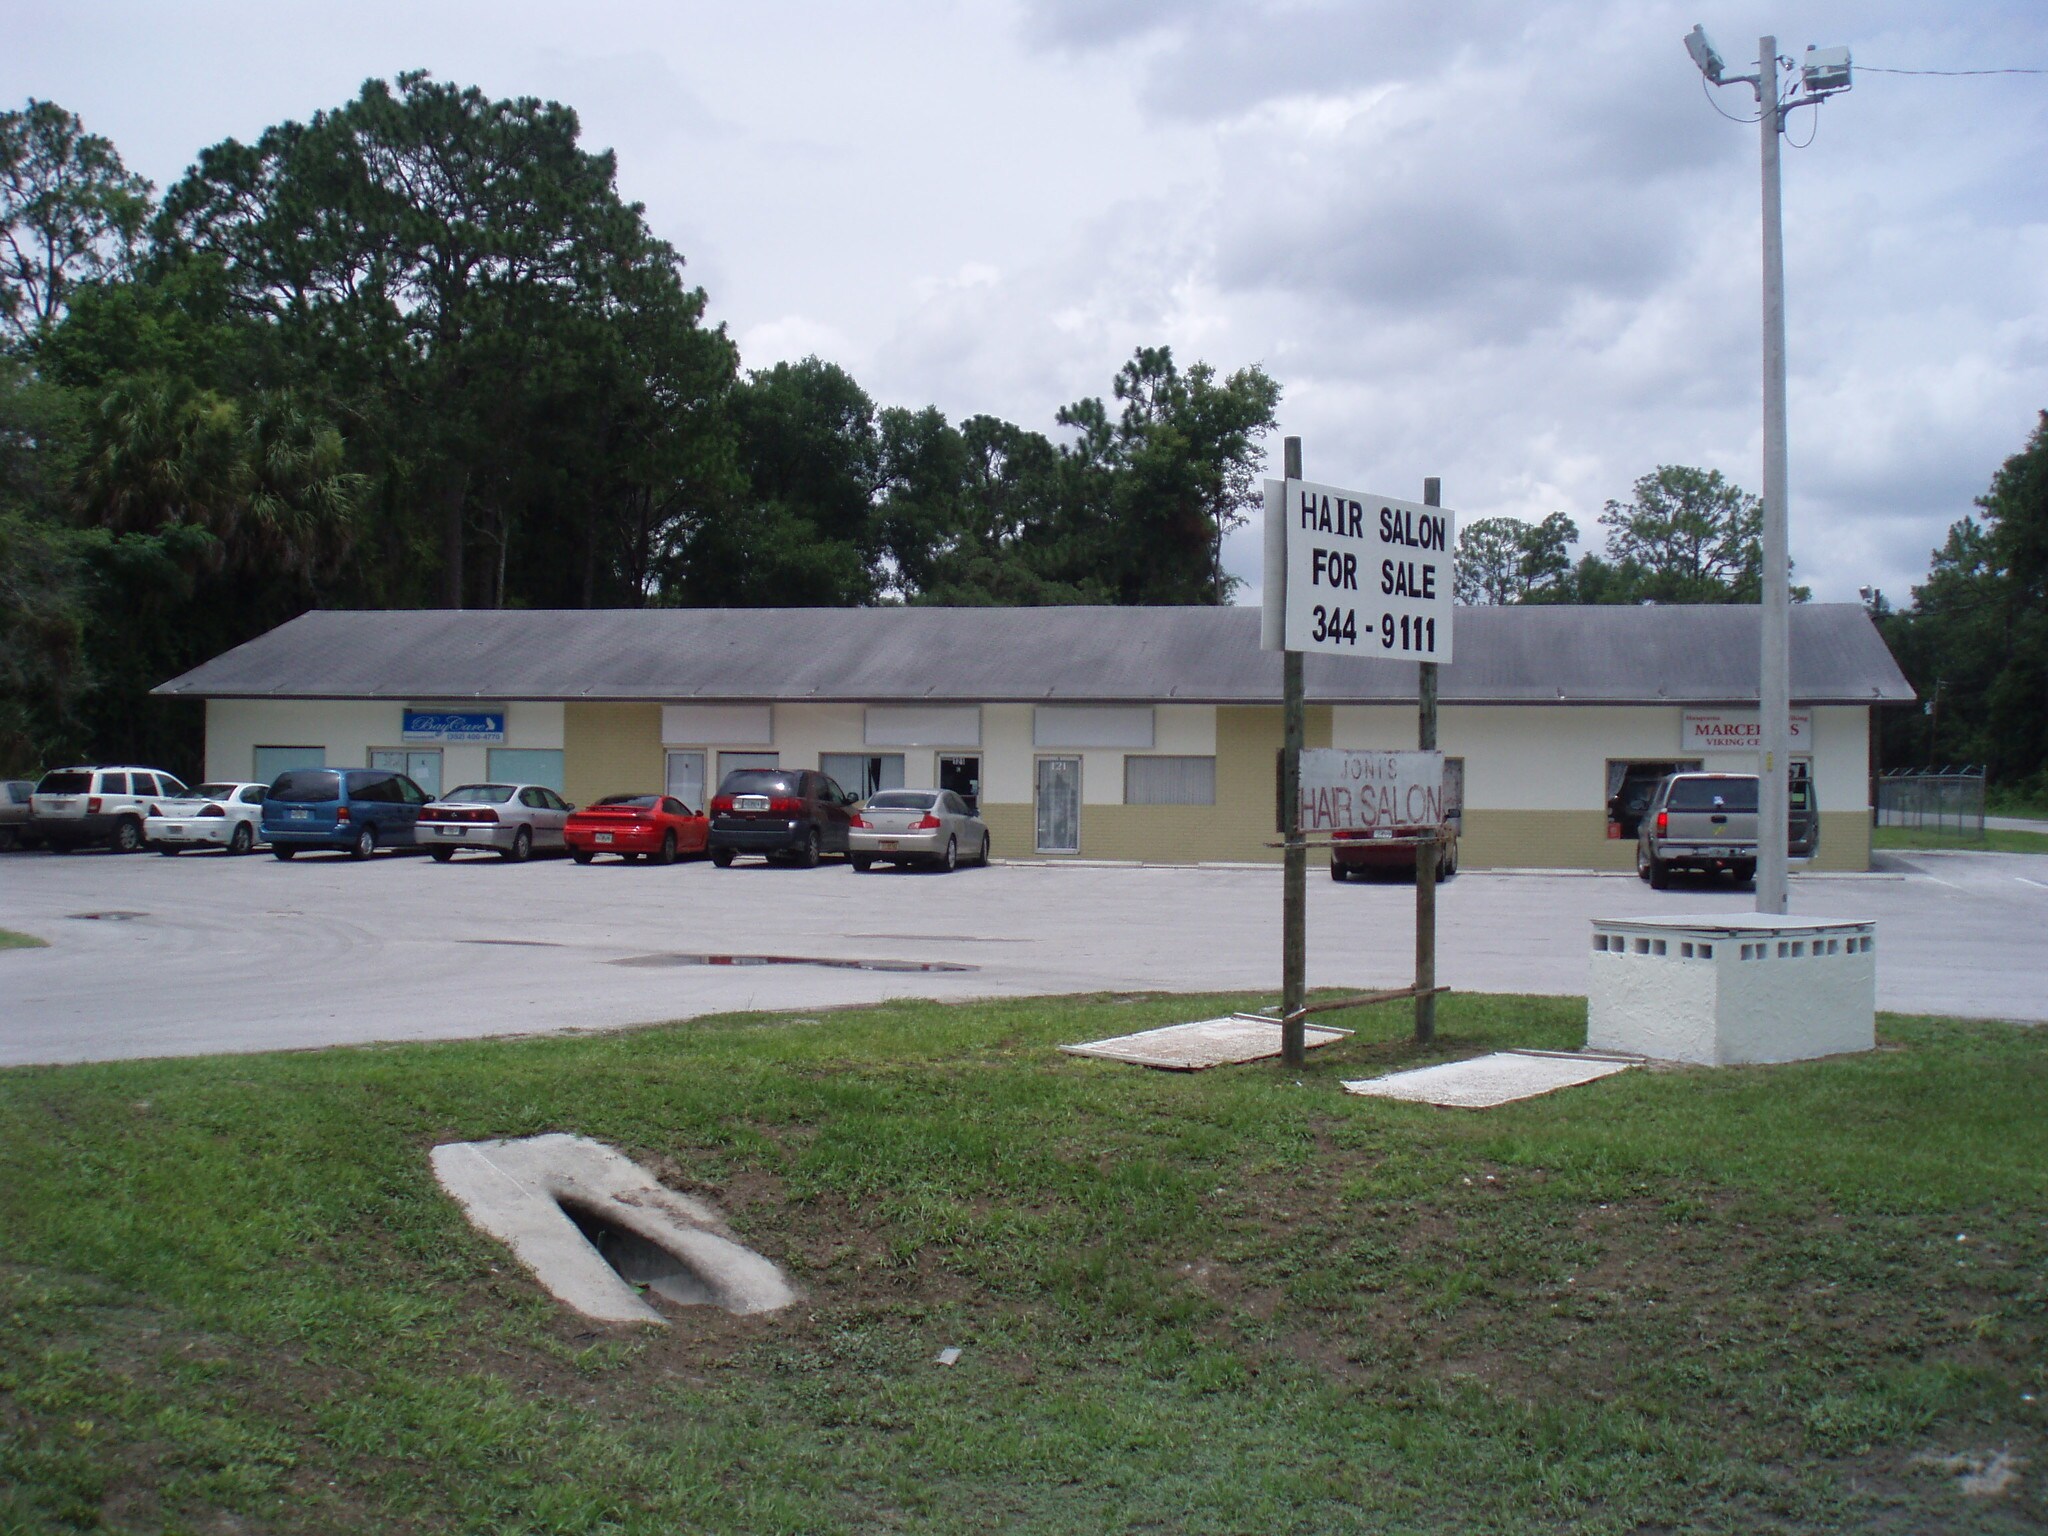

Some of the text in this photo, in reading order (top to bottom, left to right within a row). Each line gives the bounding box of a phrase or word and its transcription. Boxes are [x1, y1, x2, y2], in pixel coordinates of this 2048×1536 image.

[1301, 490, 1445, 551] HAIR SALON
[1312, 548, 1435, 599] FOR SALE
[1706, 738, 1744, 746] VIKING
[1051, 761, 1066, 770] 121
[1340, 758, 1397, 780] JONI'S
[1300, 784, 1441, 828] HAIR SALON
